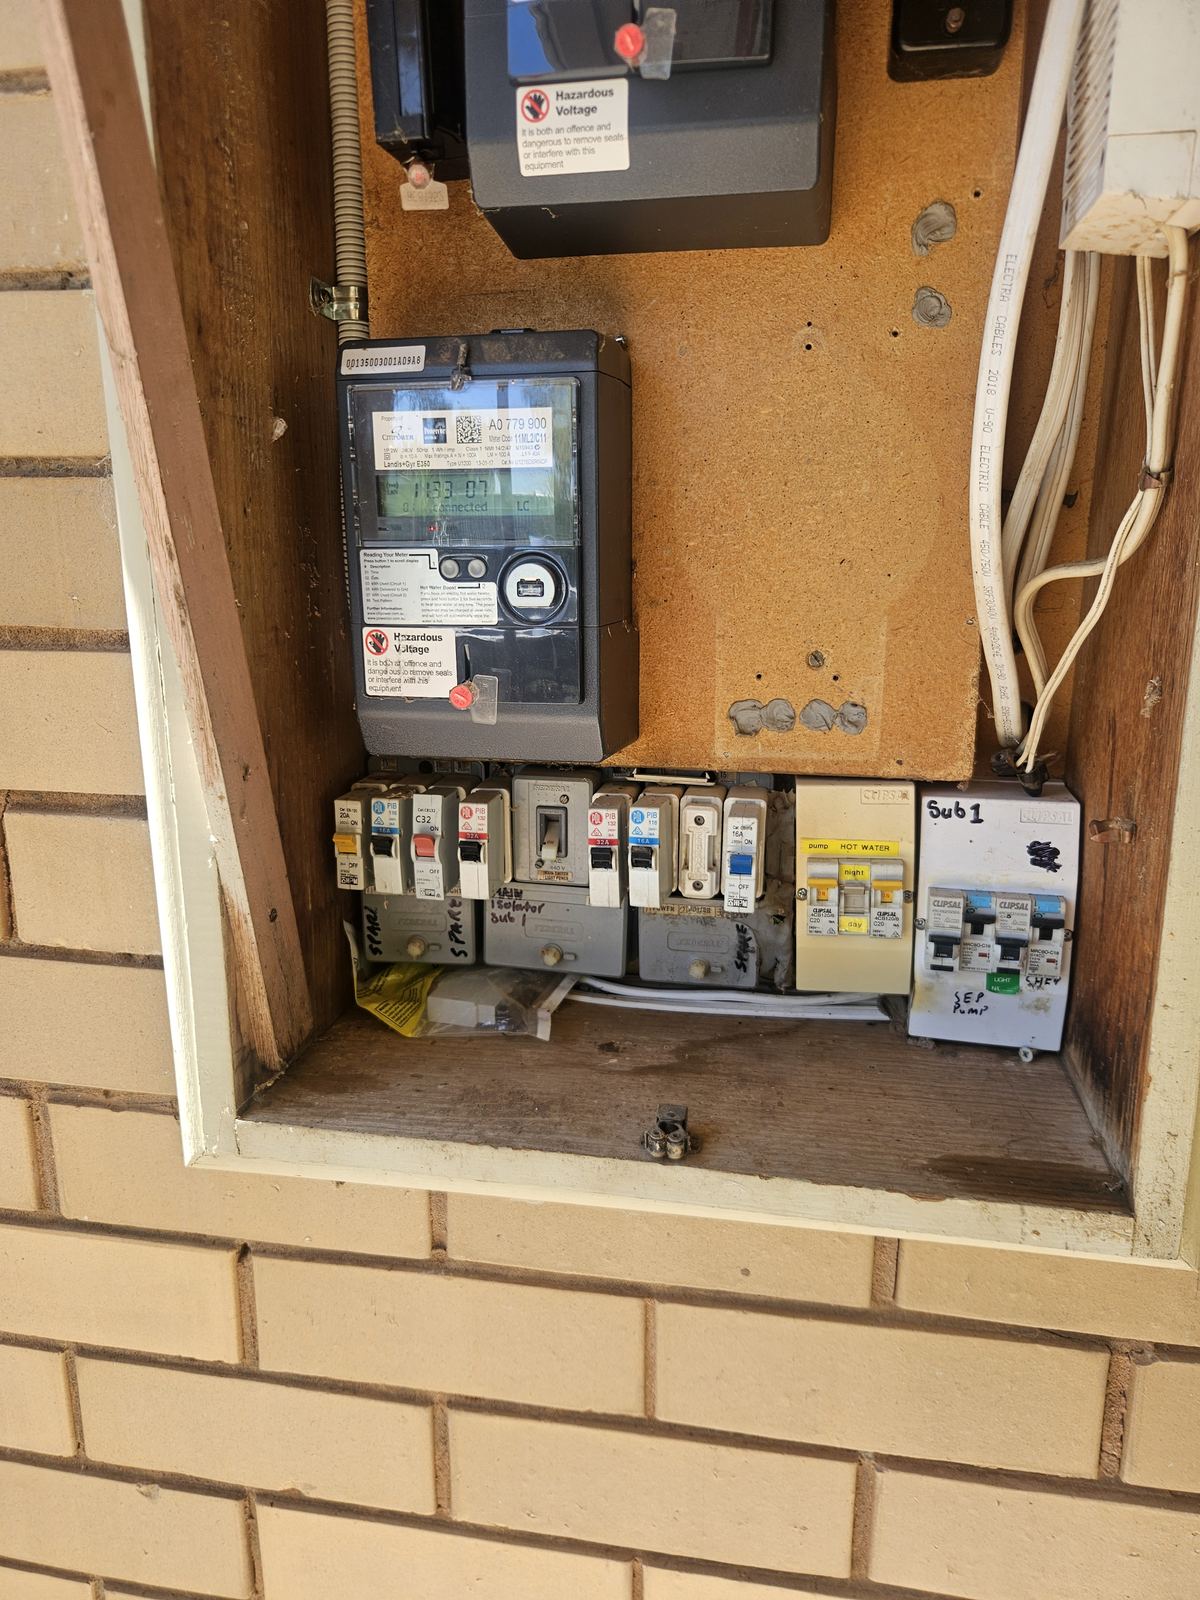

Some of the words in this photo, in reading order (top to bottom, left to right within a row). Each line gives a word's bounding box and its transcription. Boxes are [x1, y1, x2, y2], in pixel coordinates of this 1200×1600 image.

[556, 88, 614, 101] Hazardous
[556, 105, 598, 118] Voltage
[522, 129, 527, 137] It
[528, 128, 534, 136] is
[536, 126, 553, 136] both
[566, 124, 594, 133] offence
[596, 123, 612, 132] and
[522, 138, 562, 149] dangerous
[564, 138, 572, 146] to
[573, 136, 602, 145] remove
[604, 134, 624, 142] seals
[524, 152, 531, 160] or
[533, 149, 563, 159] interfere
[566, 148, 581, 156] with
[582, 147, 596, 155] this
[525, 160, 564, 171] equipment
[1000, 254, 1018, 303] ELECTRA
[992, 315, 1008, 357] CABLES
[986, 369, 999, 396] 2018
[506, 418, 525, 430] 779
[528, 417, 547, 430] 900
[384, 460, 416, 469] Landis+Gyr
[979, 445, 991, 492] ELECTRIC
[432, 501, 488, 513] connected
[394, 632, 443, 642] Hazardous
[394, 644, 430, 655] Voltage
[404, 660, 428, 668] offence
[429, 660, 442, 668] and
[927, 800, 966, 819] Sub
[970, 803, 984, 824] 1
[416, 816, 432, 824] C32
[933, 900, 962, 909] CLIPSAL
[999, 901, 1029, 911] CLIPSAL
[448, 899, 468, 958] SPARE
[954, 992, 984, 1003] SEP
